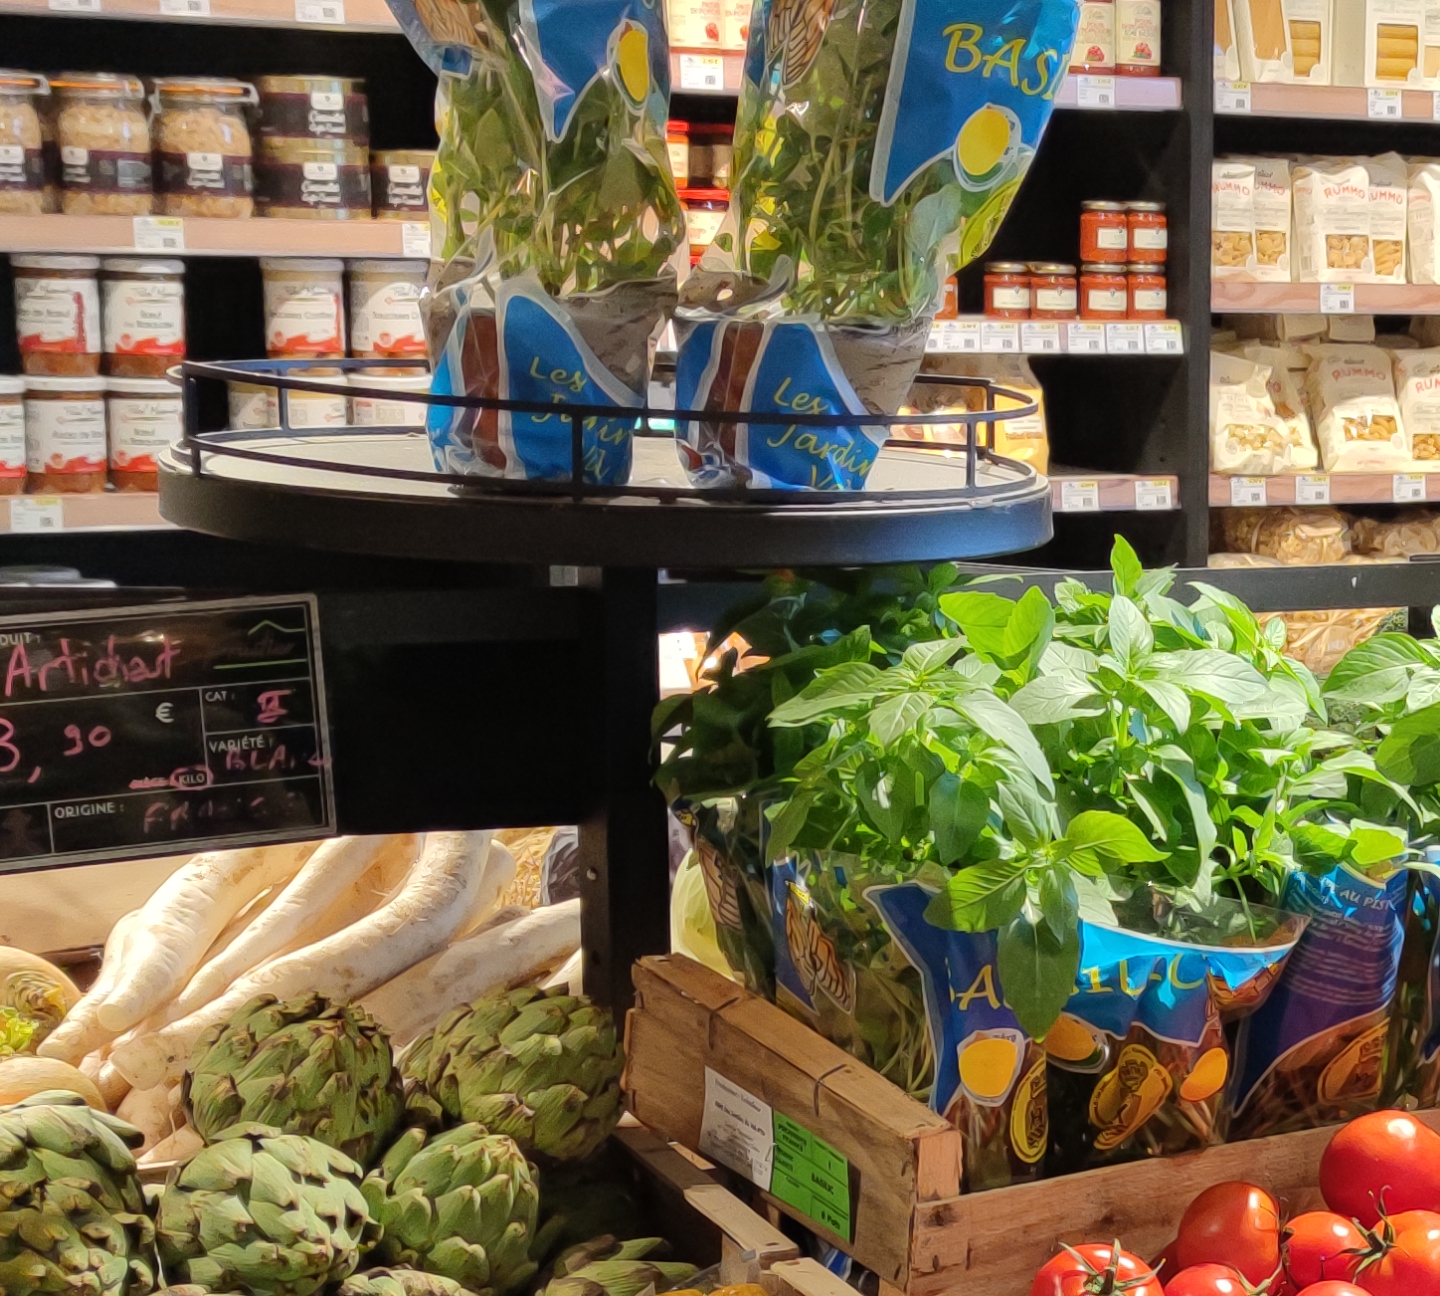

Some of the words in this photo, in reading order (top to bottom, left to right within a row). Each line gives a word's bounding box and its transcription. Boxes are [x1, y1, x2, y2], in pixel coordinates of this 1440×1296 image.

[1324, 186, 1366, 200] RUMMO
[1331, 366, 1387, 383] RUMMO
[205, 691, 228, 703] CAT
[155, 702, 174, 724] €
[178, 773, 206, 785] KILO
[54, 802, 117, 819] ORIGINE
